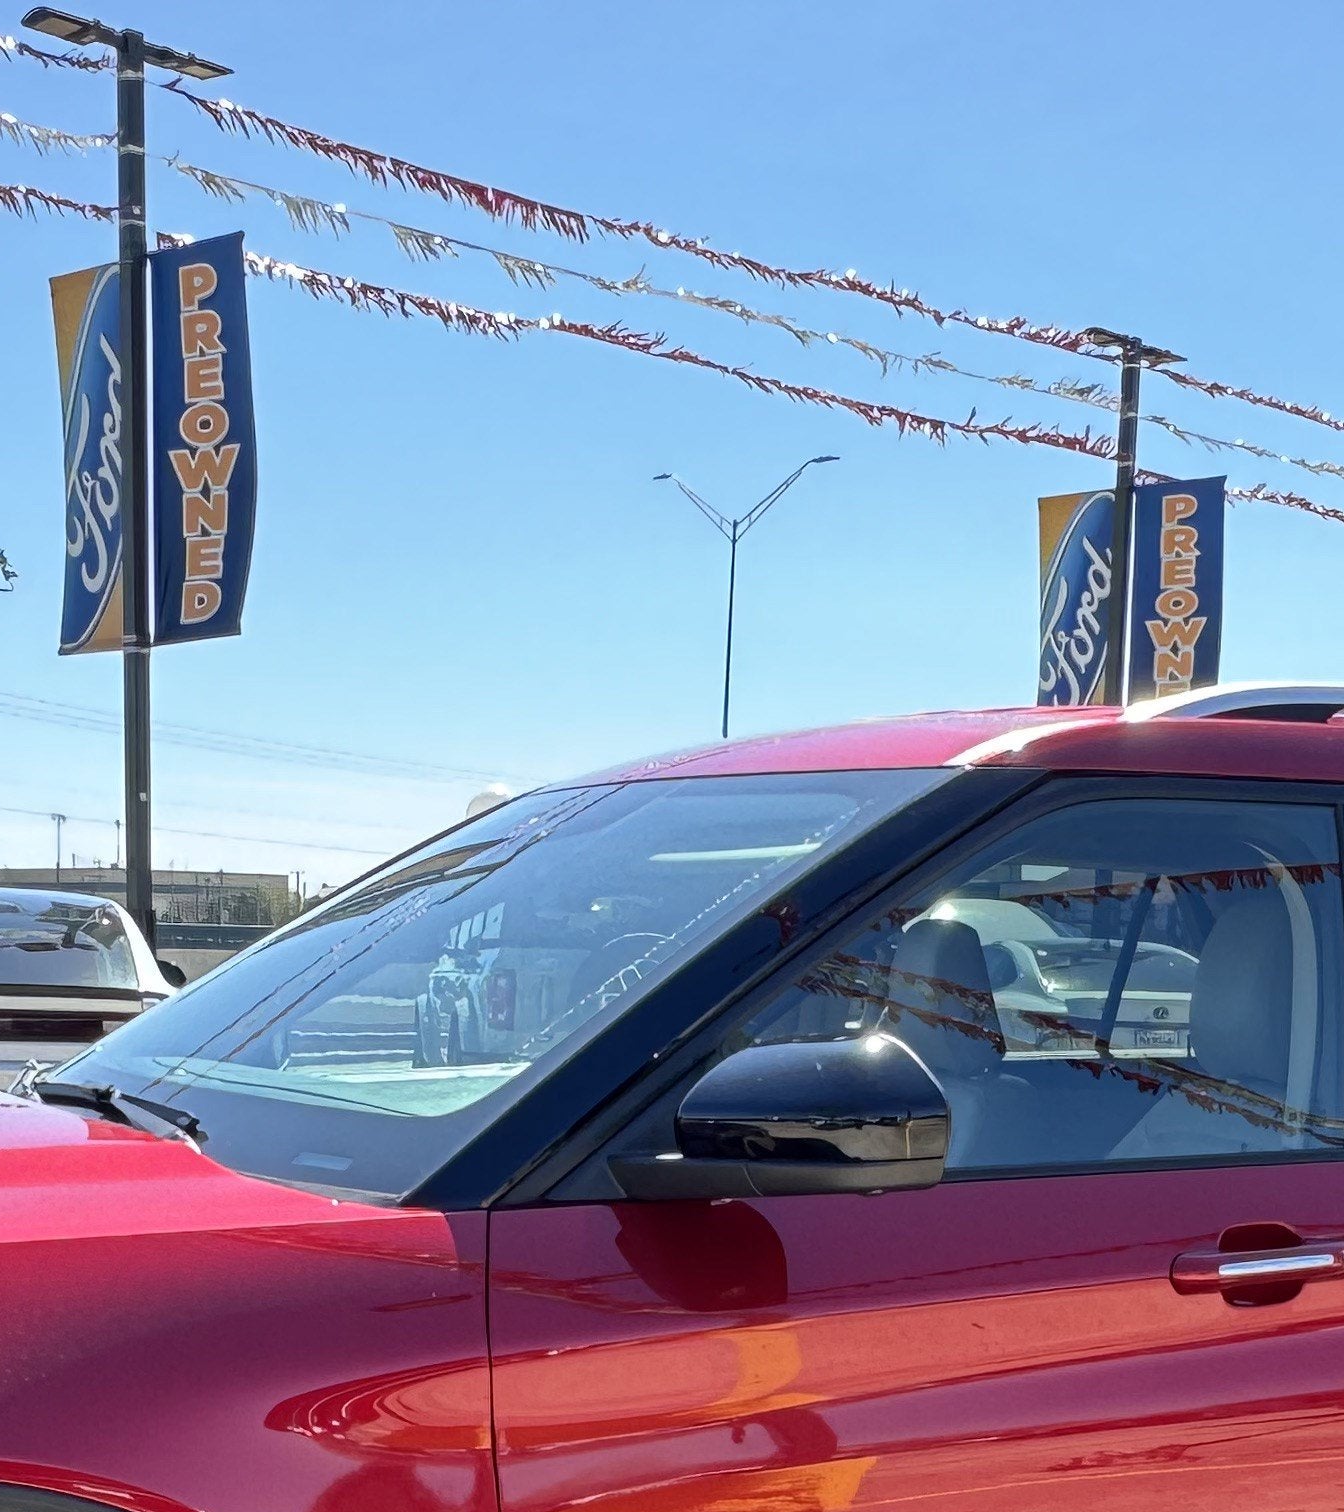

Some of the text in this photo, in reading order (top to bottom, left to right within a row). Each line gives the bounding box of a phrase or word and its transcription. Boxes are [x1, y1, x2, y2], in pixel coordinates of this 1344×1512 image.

[168, 263, 241, 625] PREOWNED
[1040, 535, 1113, 706] Ford
[1145, 494, 1208, 698] PREOWN
